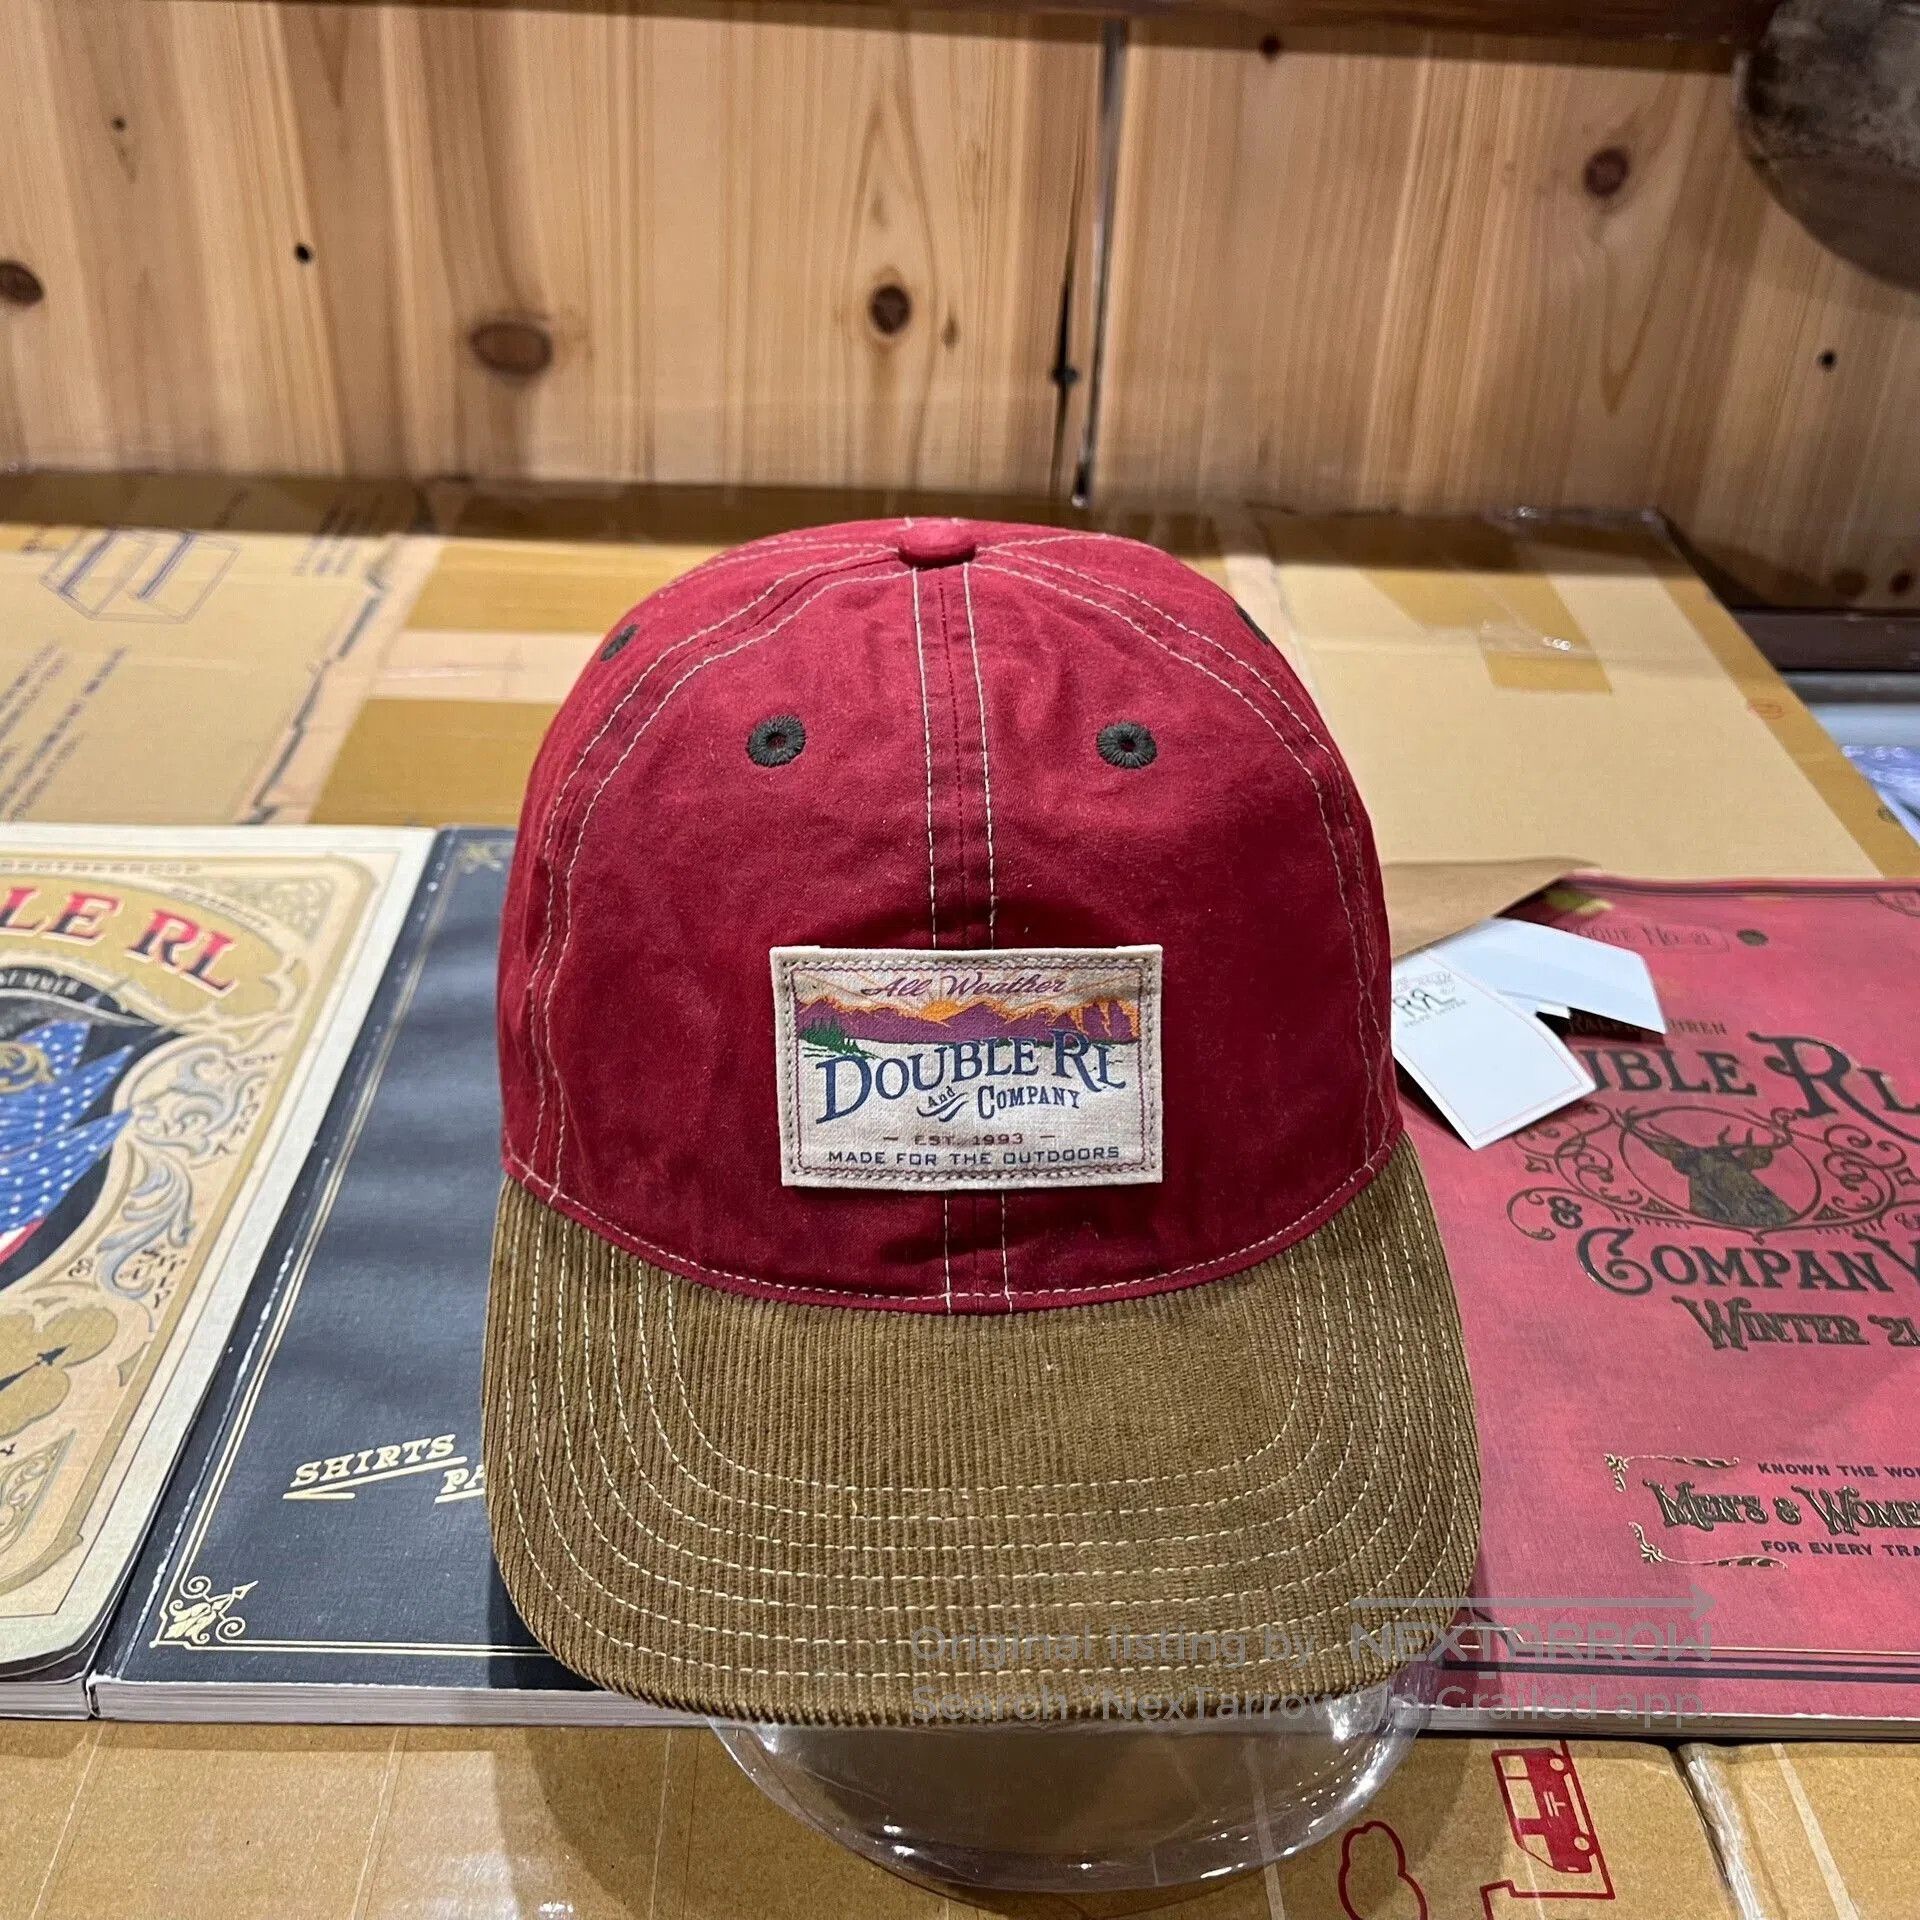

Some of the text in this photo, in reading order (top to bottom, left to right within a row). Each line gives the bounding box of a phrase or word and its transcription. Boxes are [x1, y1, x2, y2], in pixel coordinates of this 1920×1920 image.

[125, 907, 238, 996] RL
[861, 971, 1068, 996] All Weather
[815, 1028, 1127, 1125] DOUBLE RL
[977, 1084, 1081, 1121] COMPANY
[972, 1133, 1025, 1146] 1993
[828, 1146, 1120, 1166] MADE FOR THE OUTDOORS
[1671, 1296, 1870, 1352] WINTER
[290, 1434, 456, 1487] SHIRTS
[1757, 1462, 1831, 1477] KNOWN
[1837, 1464, 1879, 1478] THE
[1773, 1496, 1802, 1527] &
[1761, 1540, 1803, 1554] FOR
[1808, 1541, 1873, 1556] EVERY
